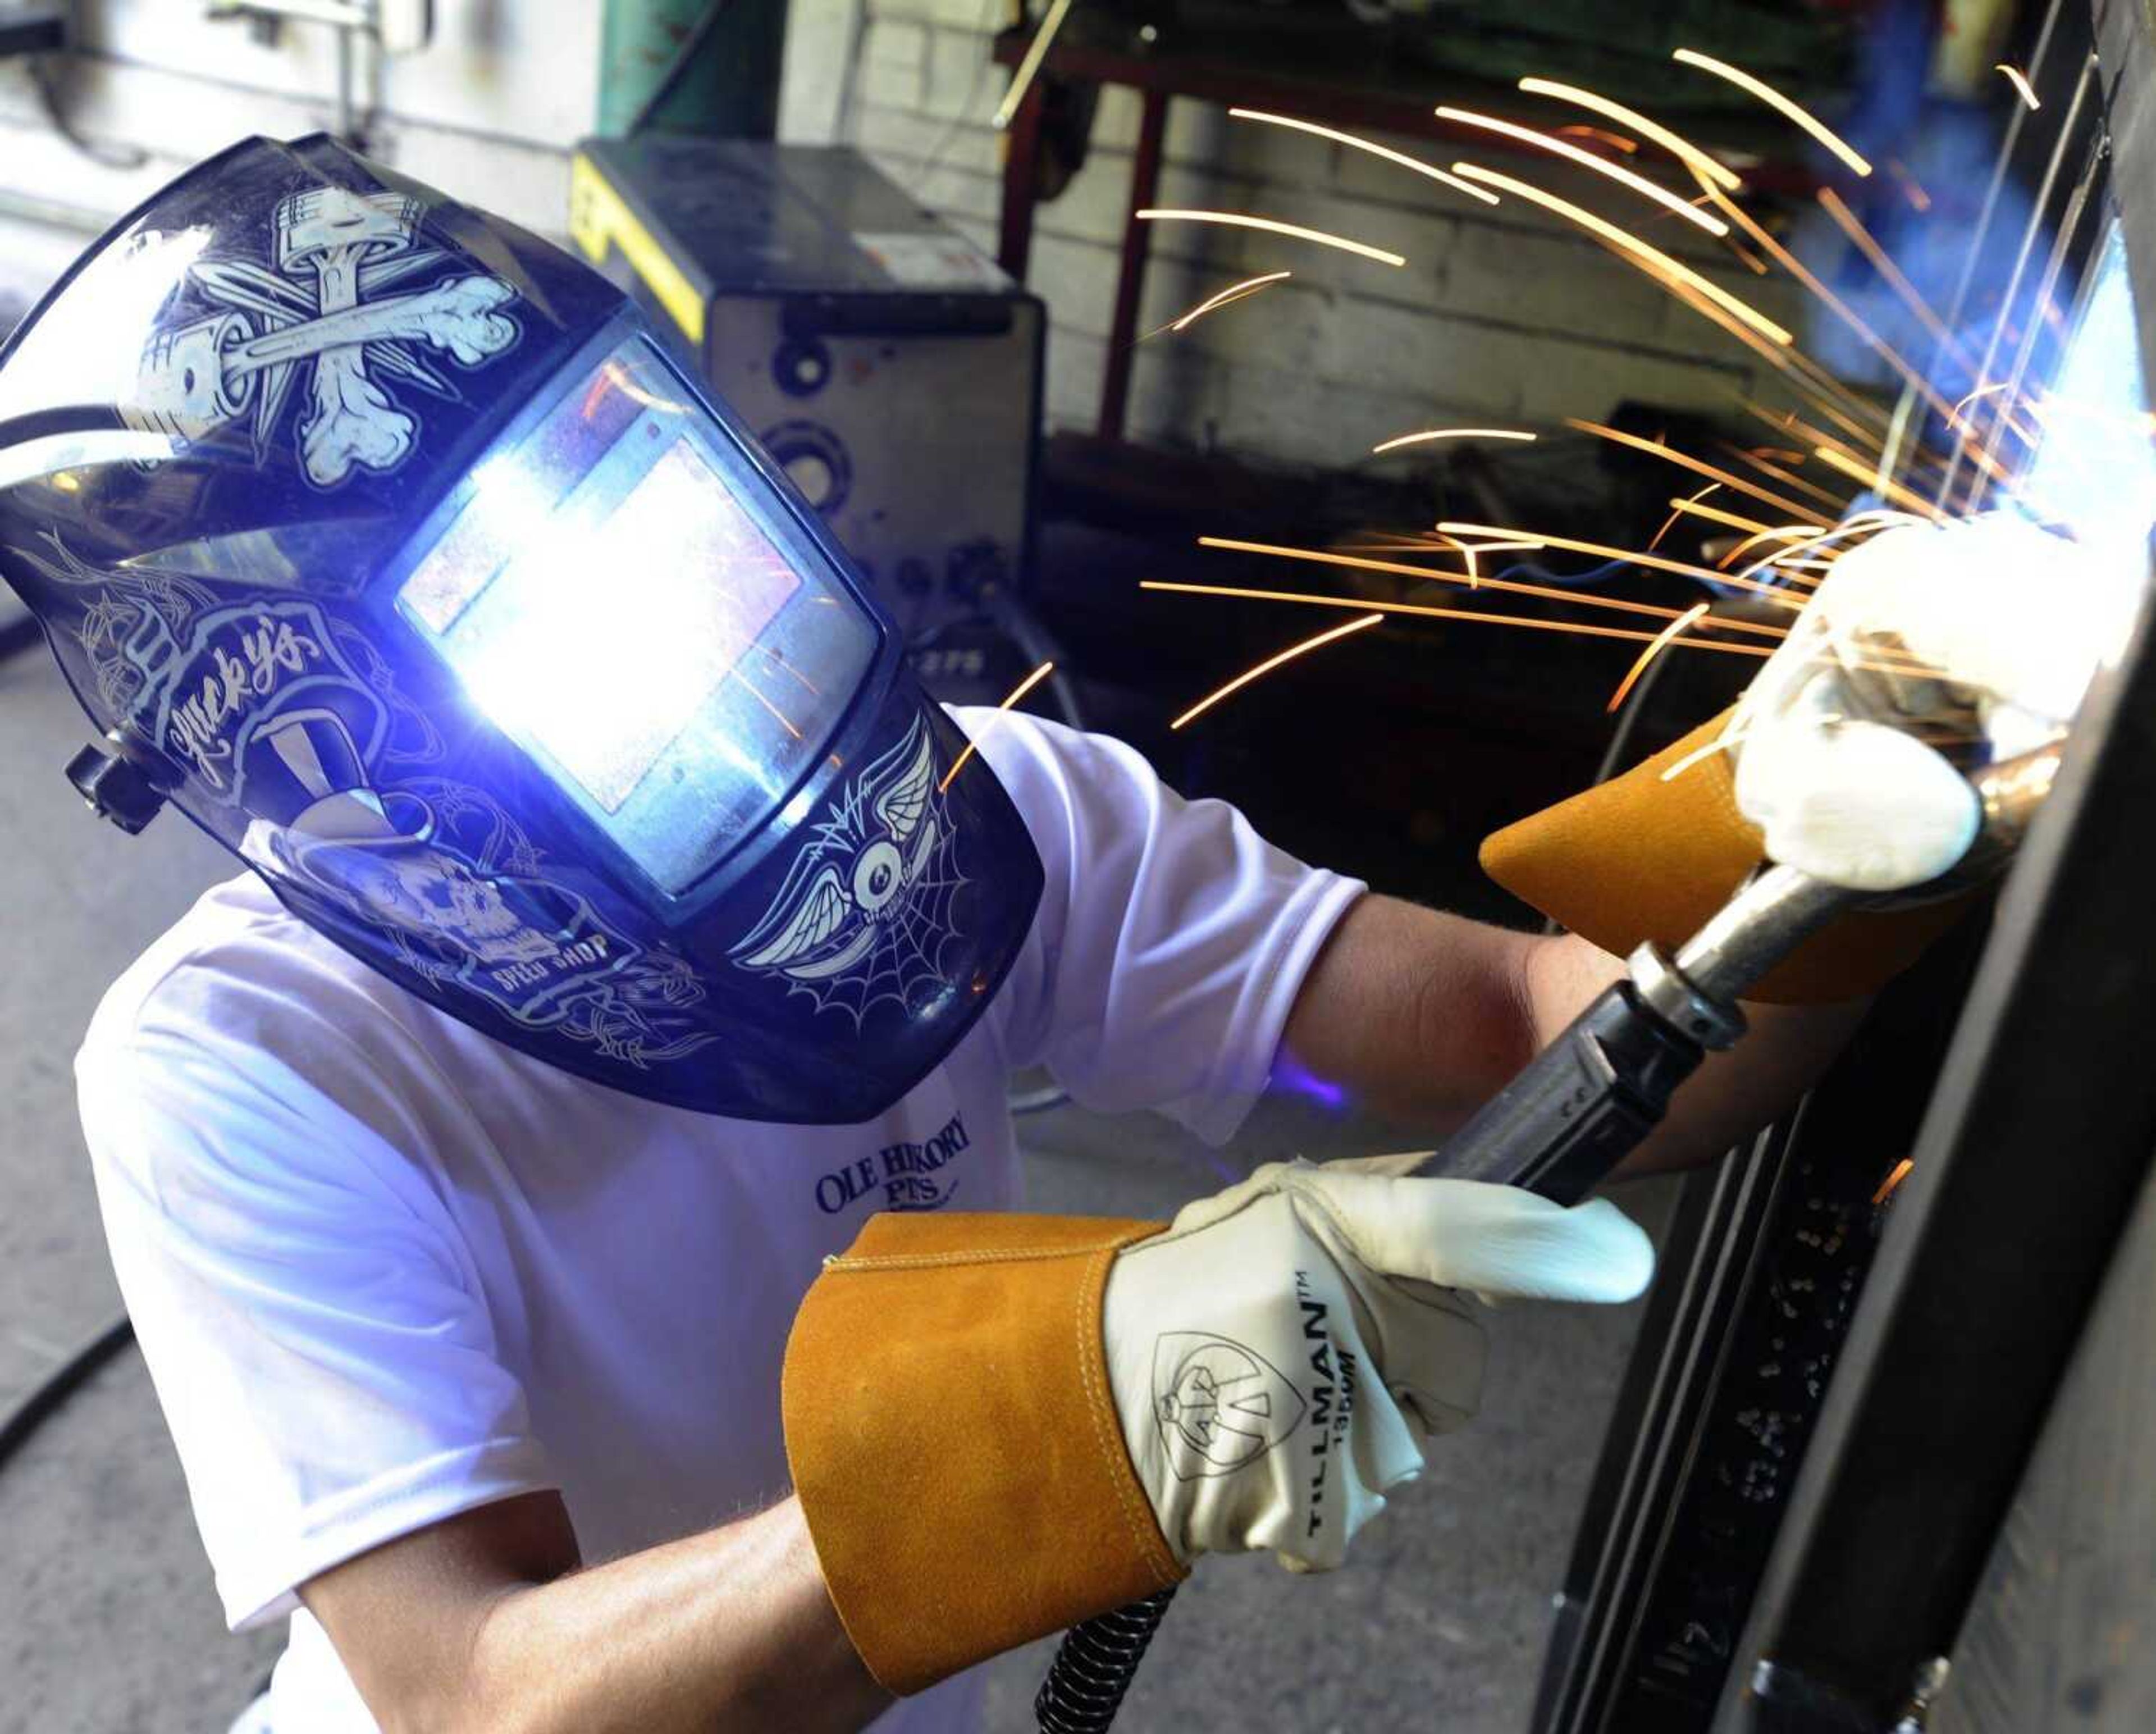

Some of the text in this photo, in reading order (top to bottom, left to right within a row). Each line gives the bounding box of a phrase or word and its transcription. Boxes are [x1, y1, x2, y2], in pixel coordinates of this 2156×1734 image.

[491, 934, 608, 993] SPEED SHOP
[816, 1157, 879, 1214] OLE
